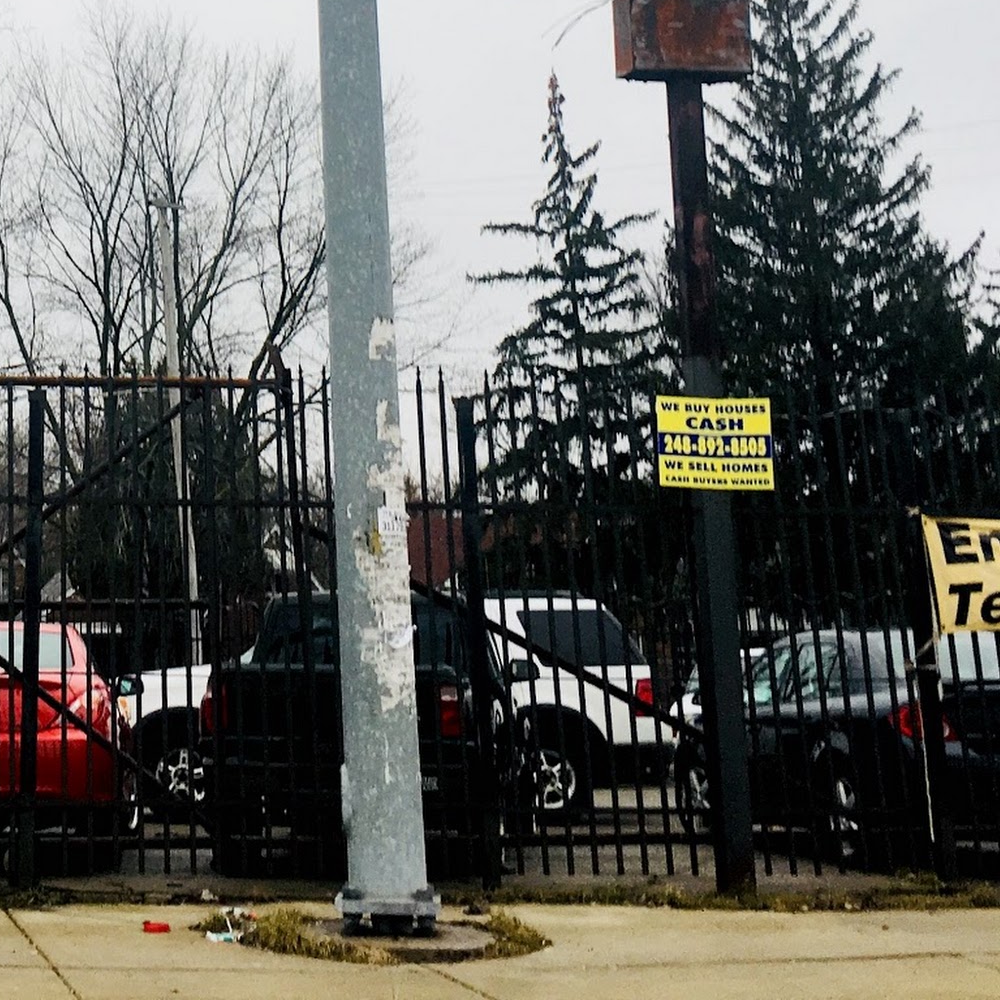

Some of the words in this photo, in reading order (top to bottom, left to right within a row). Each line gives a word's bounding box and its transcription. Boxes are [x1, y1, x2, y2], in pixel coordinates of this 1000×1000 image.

[661, 402, 680, 412] WE
[685, 403, 710, 413] BUY
[715, 404, 766, 414] HOUSES
[686, 417, 744, 431] CASH
[664, 460, 683, 470] WE
[688, 462, 717, 473] SELL
[722, 463, 768, 473] HOMES
[731, 477, 770, 486] WANTED
